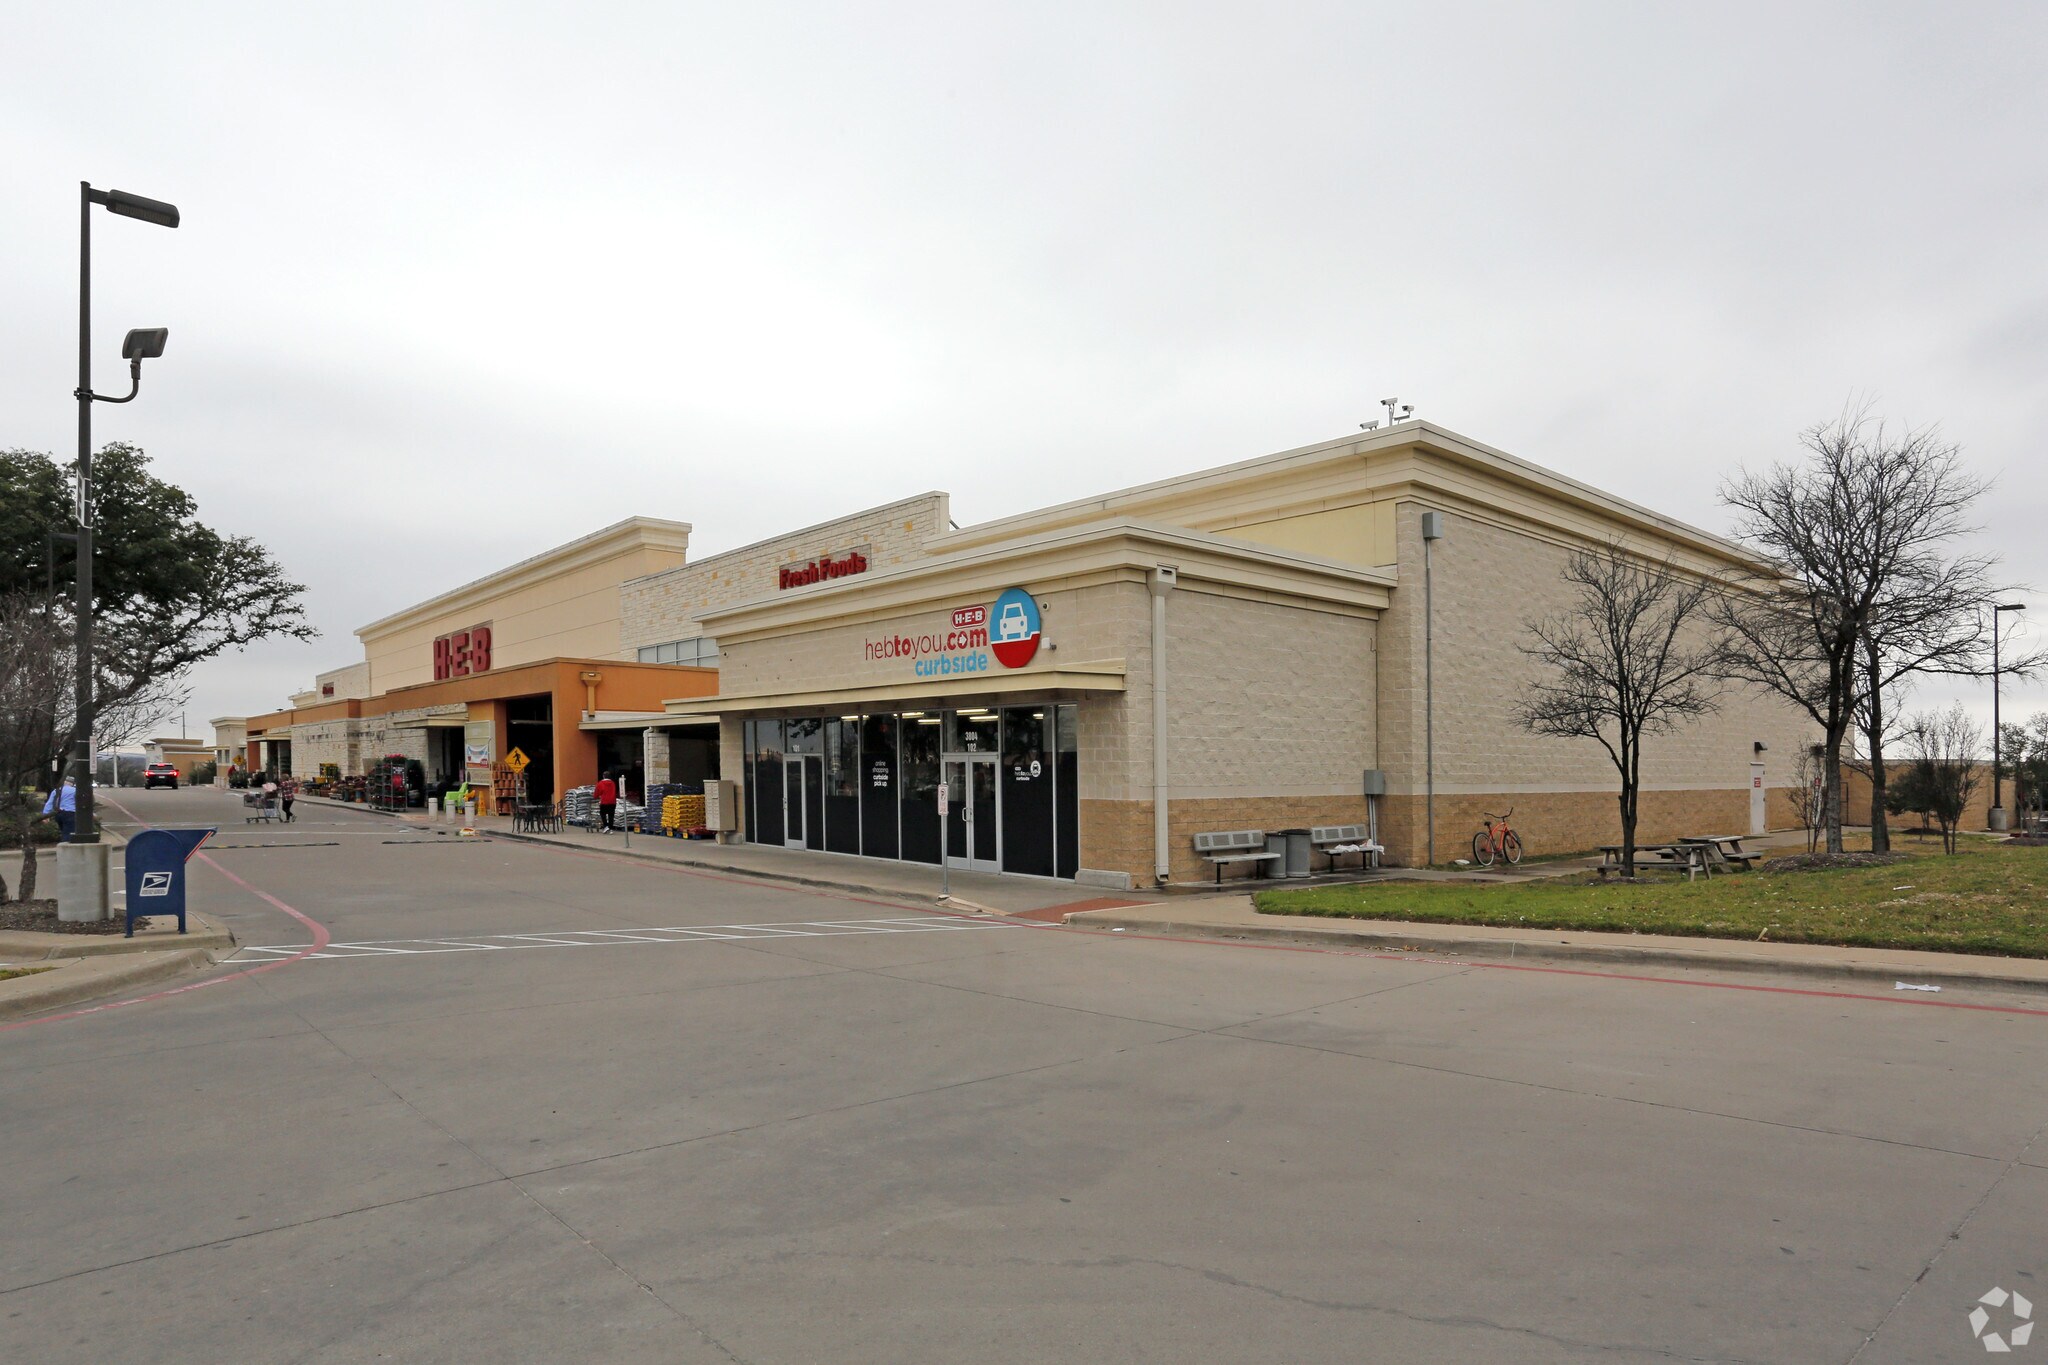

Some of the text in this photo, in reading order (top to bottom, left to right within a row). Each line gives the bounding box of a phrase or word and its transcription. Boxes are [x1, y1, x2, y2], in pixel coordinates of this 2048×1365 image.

[780, 552, 867, 590] Fresh Foods
[865, 627, 988, 661] hebtoyou.com
[915, 651, 988, 677] curbside
